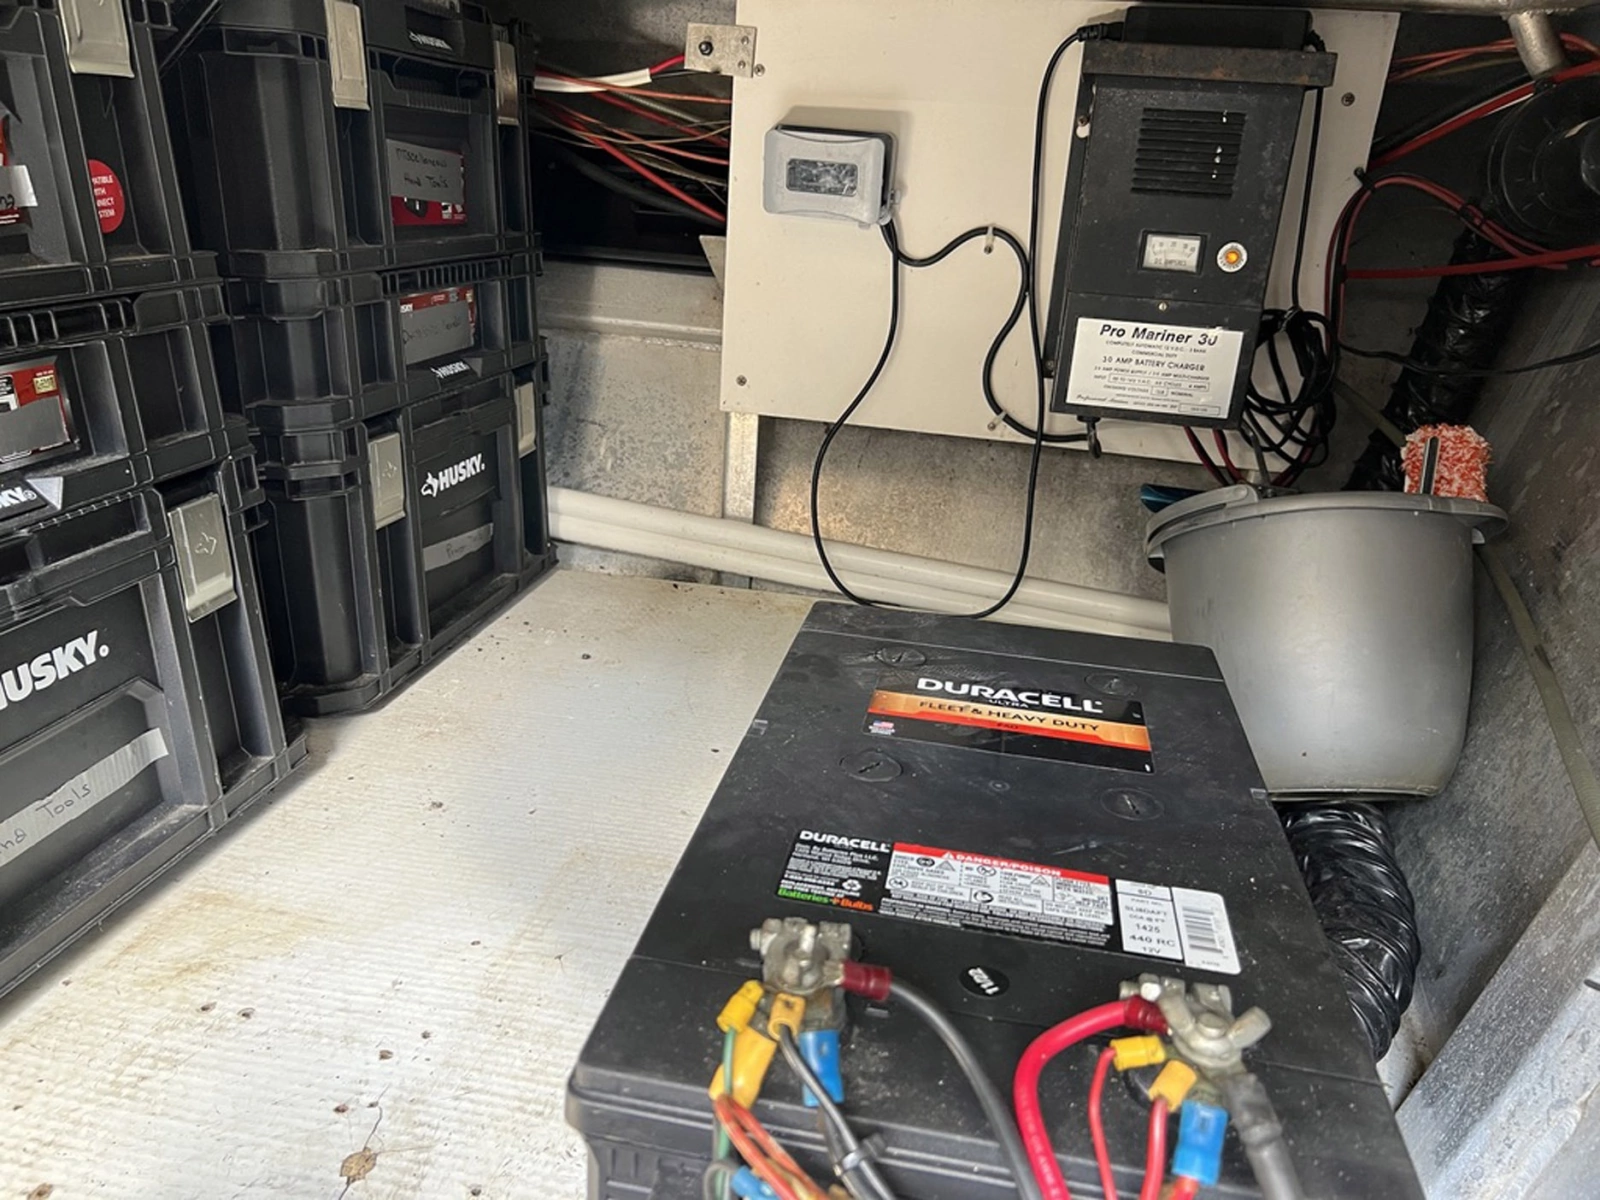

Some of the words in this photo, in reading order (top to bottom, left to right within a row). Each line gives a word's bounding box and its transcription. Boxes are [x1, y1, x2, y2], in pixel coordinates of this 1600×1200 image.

[1100, 324, 1126, 338] Pro
[1132, 327, 1192, 344] Mariner
[1135, 358, 1165, 368] BATTERY
[1167, 361, 1205, 372] CHARGER
[917, 678, 1103, 713] DURACELL
[988, 699, 1029, 708] ULTRA
[920, 701, 964, 713] FLEET
[988, 709, 1047, 724] HEAVY
[1053, 718, 1100, 732] DUTY
[35, 784, 91, 818] Tools
[800, 830, 890, 852] DURACELL
[956, 854, 1061, 876] DANGER/POISON
[1136, 923, 1160, 933] 1425
[1129, 934, 1152, 943] 440
[1157, 938, 1175, 947] RC
